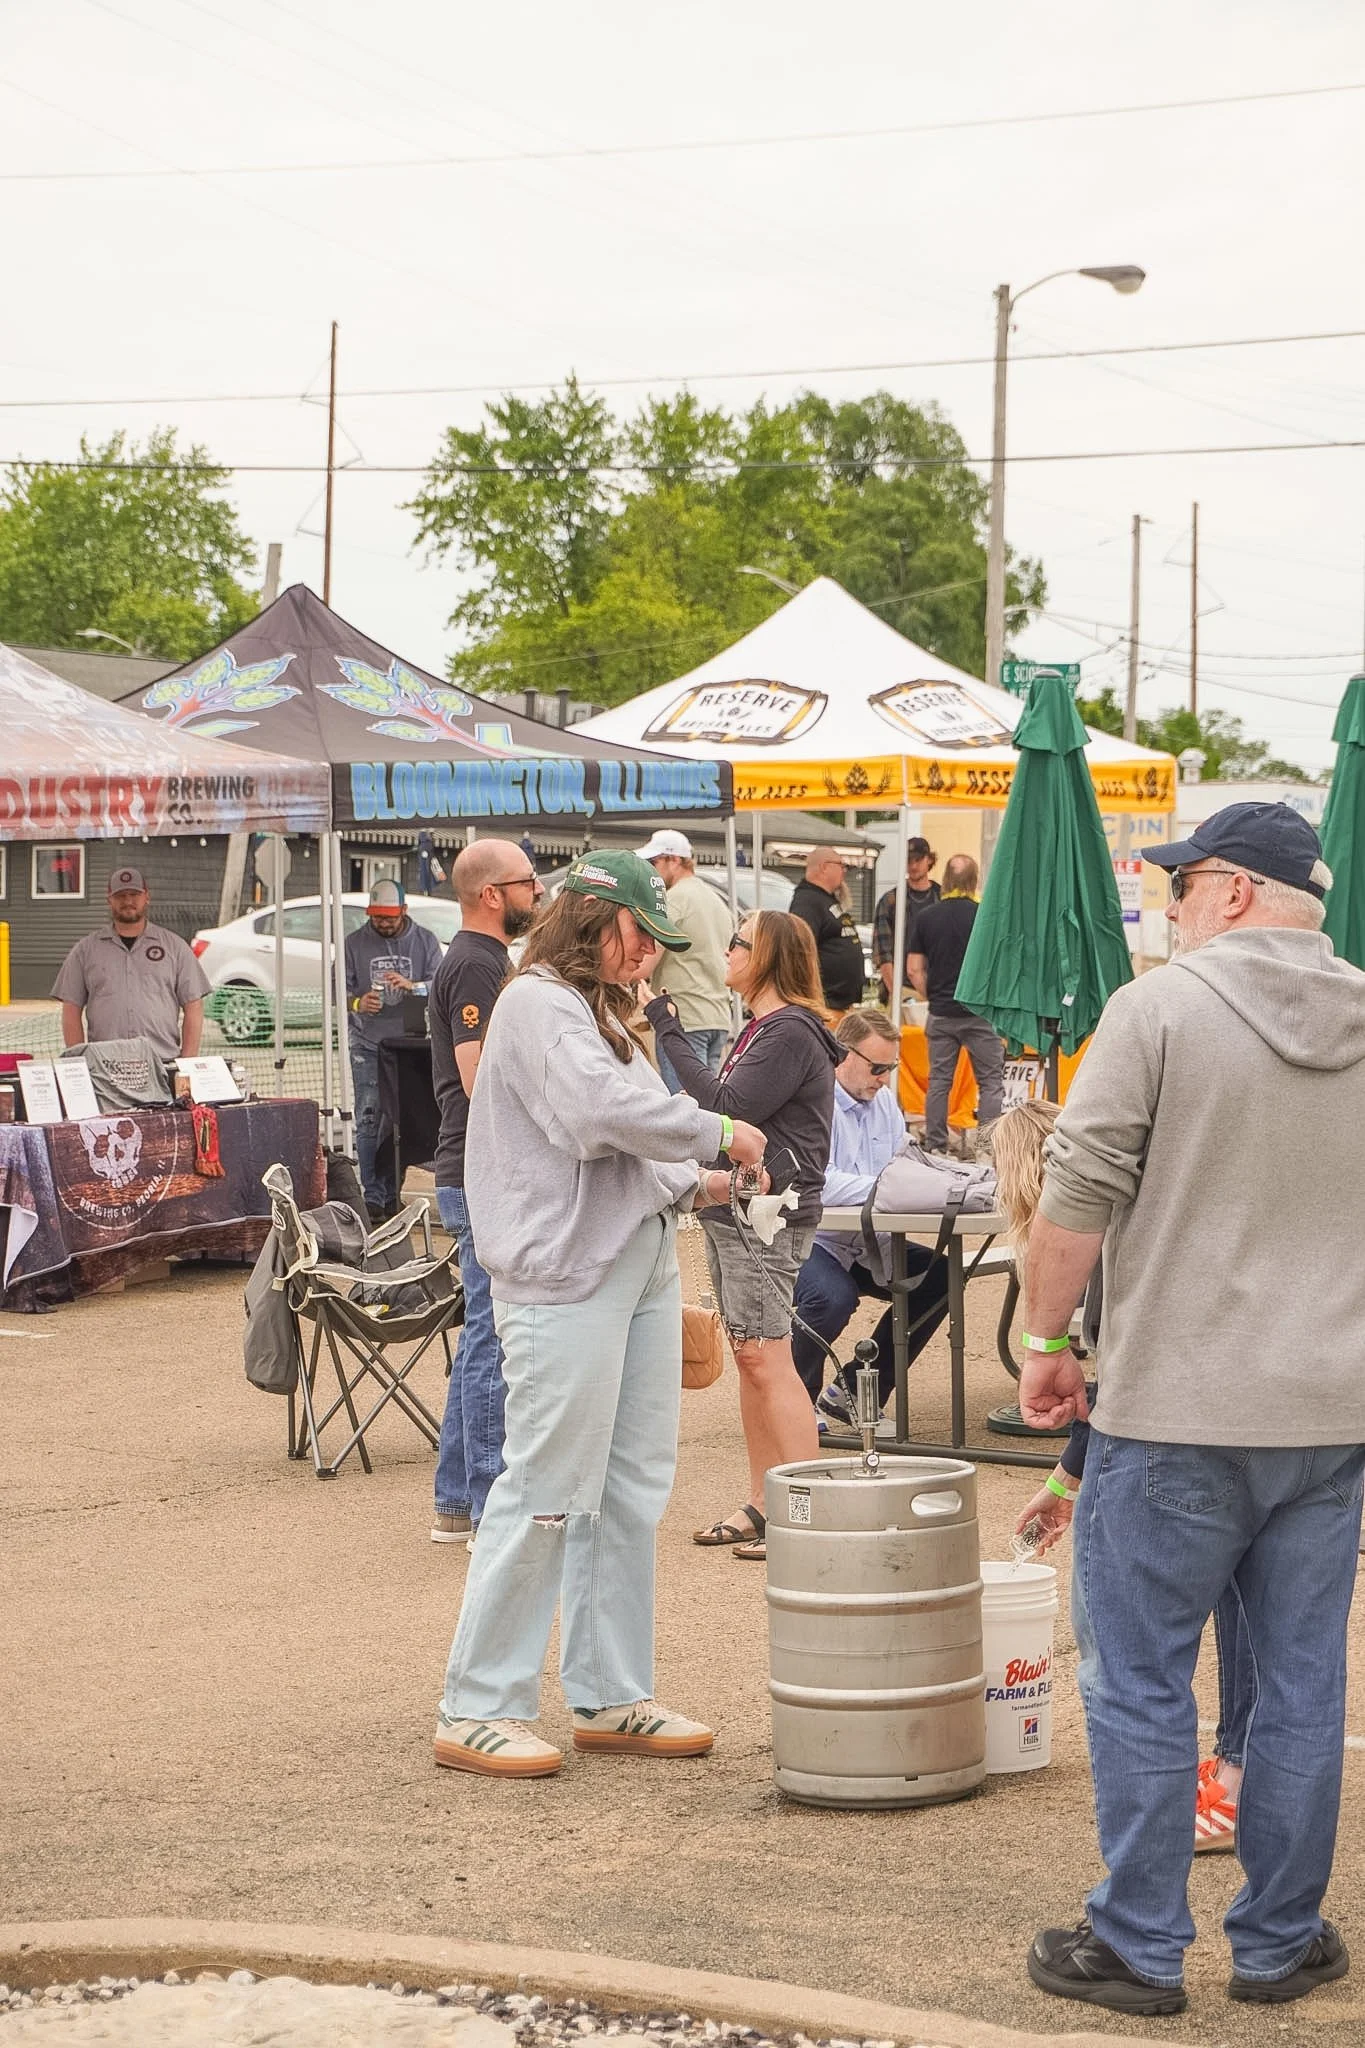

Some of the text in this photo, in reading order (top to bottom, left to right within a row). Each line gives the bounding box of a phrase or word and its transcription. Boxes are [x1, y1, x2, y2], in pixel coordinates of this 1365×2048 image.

[1003, 664, 1010, 682] E
[699, 690, 797, 714] RESERVE
[895, 692, 967, 716] RESERVE
[167, 776, 253, 800] BREWING
[350, 760, 722, 820] BLOOMINGTON, ILLINOIS
[761, 784, 808, 800] ALES
[80, 1198, 119, 1218] BREWING
[985, 1687, 1027, 1702] FARM
[1029, 1686, 1036, 1697] &
